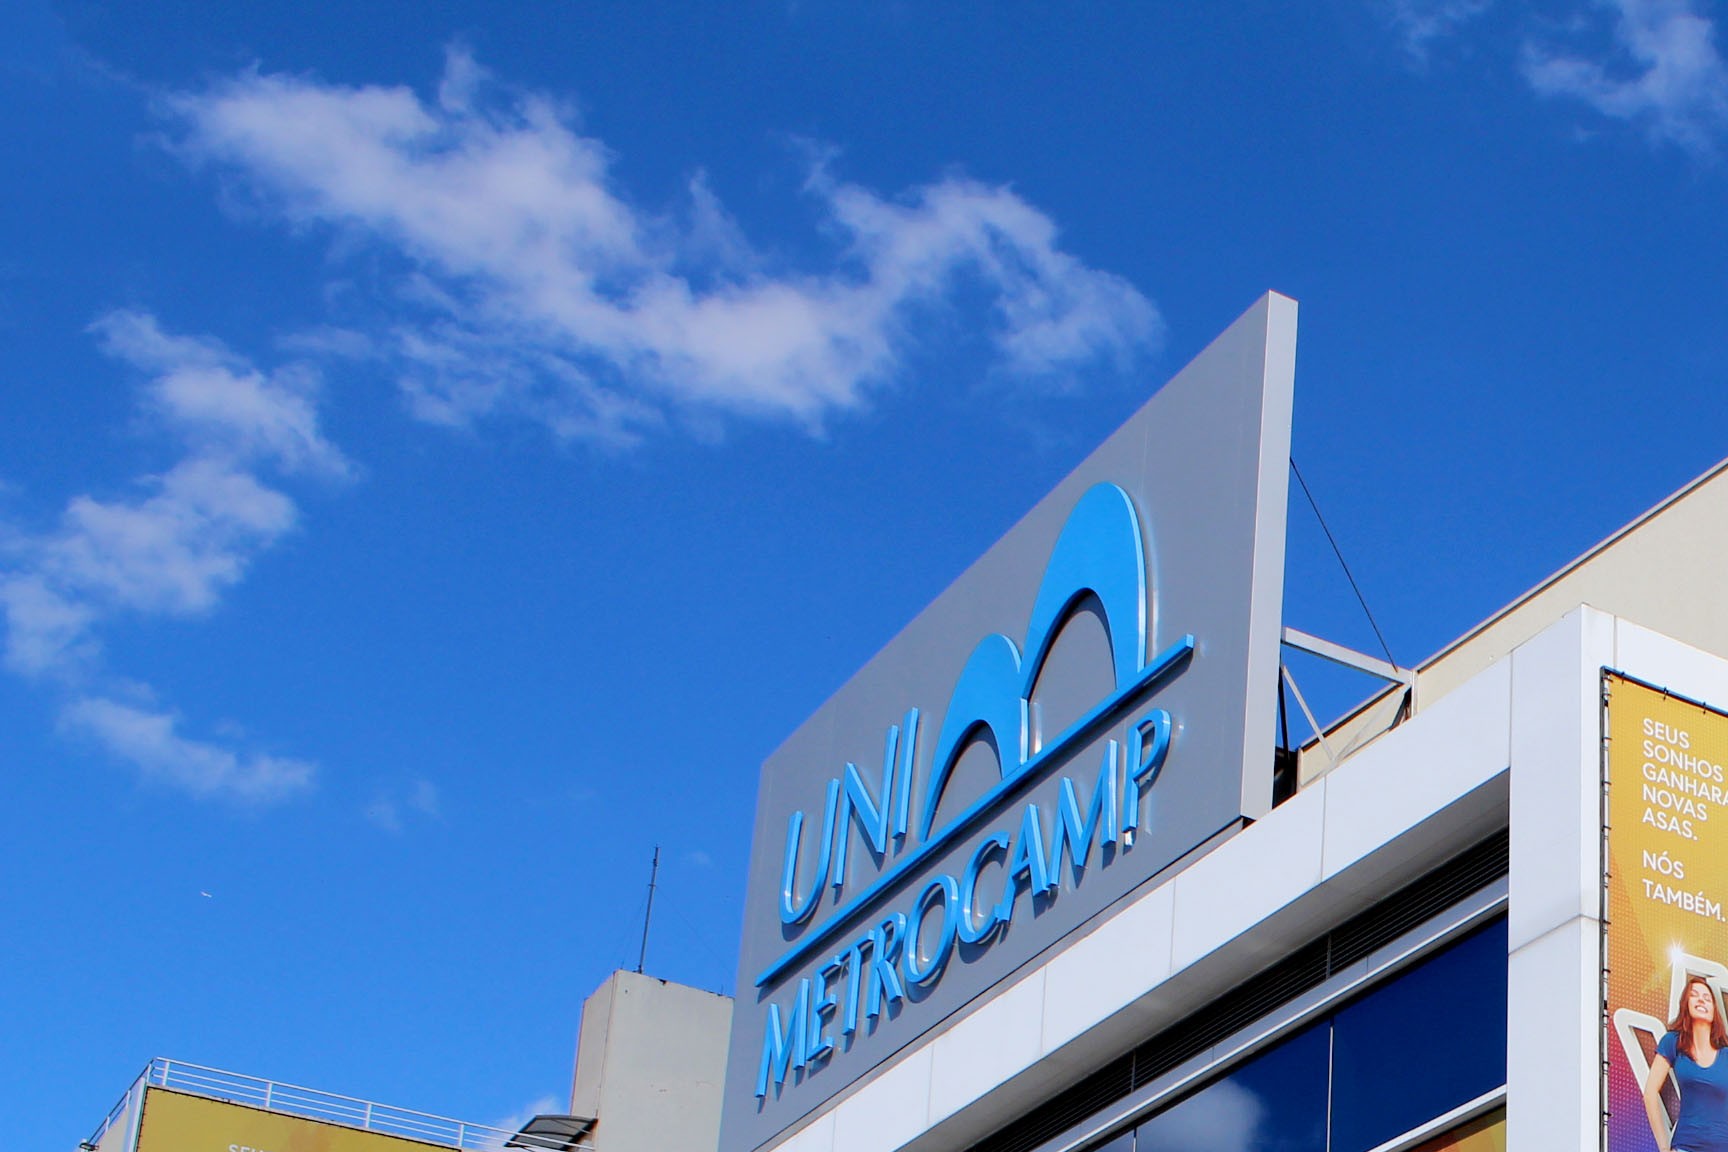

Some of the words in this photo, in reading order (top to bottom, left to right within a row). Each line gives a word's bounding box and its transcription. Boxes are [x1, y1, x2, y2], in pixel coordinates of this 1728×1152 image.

[1643, 718, 1690, 749] SEUS
[1643, 740, 1724, 782] SONHOS
[779, 707, 919, 924] UNI
[1643, 785, 1708, 821] NOVAS
[1643, 810, 1698, 840] ASAS.
[1643, 850, 1684, 879] NÓS
[755, 709, 1171, 1098] METROCAMP
[1642, 879, 1727, 922] TAMBÉM.
